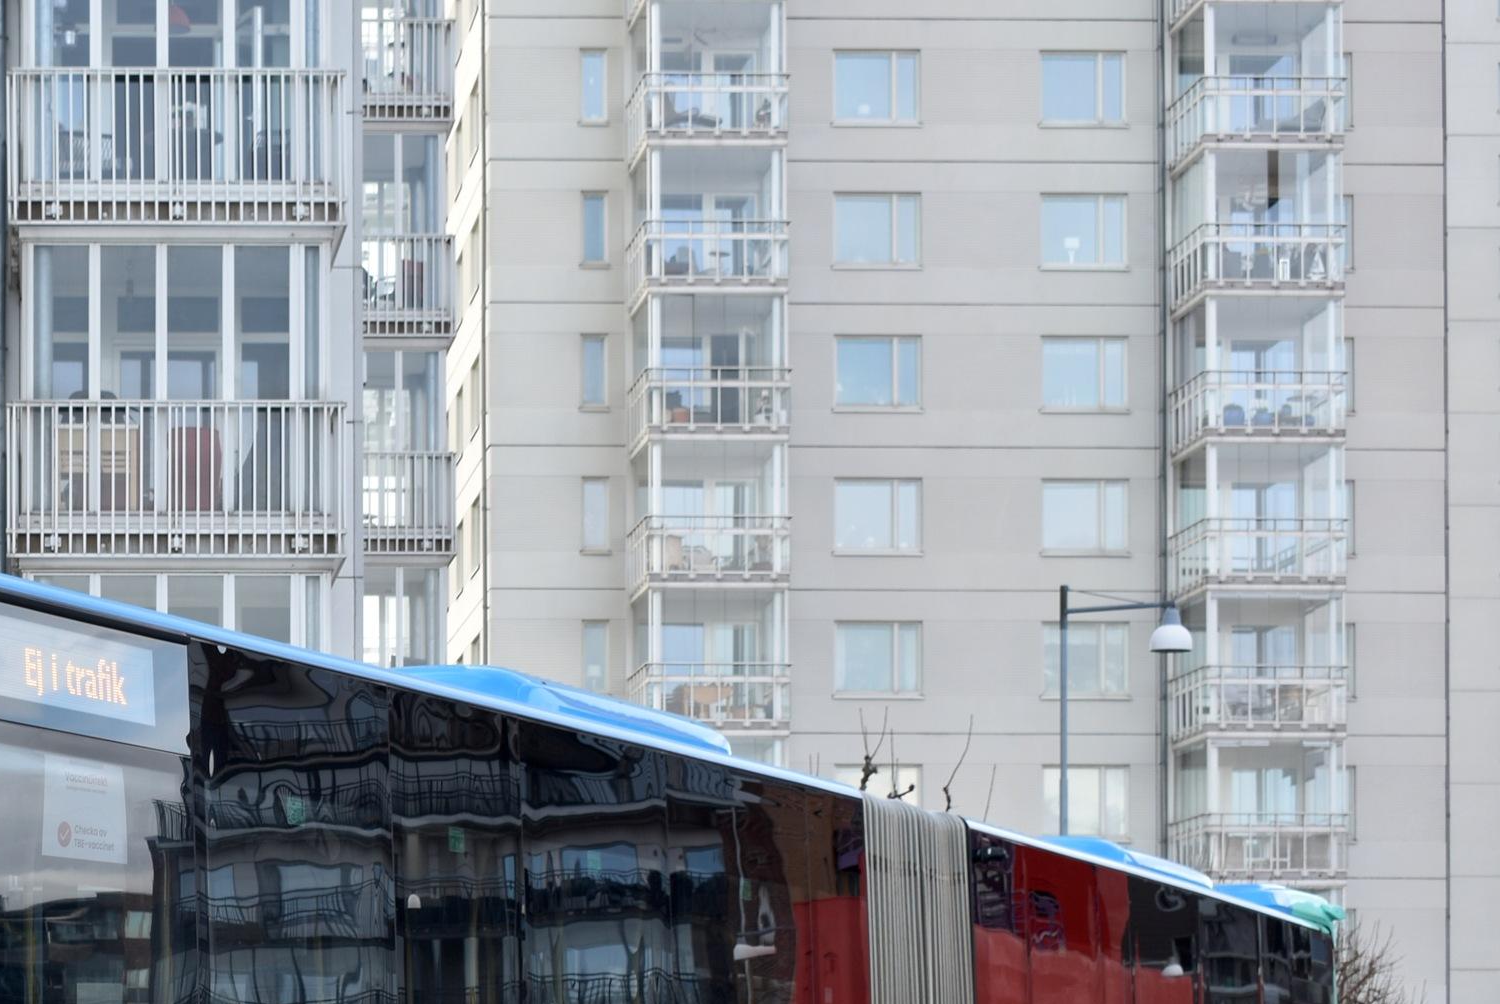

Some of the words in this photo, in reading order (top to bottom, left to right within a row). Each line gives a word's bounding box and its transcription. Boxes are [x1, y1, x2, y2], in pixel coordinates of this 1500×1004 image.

[25, 647, 44, 696] Ej
[51, 653, 59, 691] i
[66, 658, 127, 705] trafik
